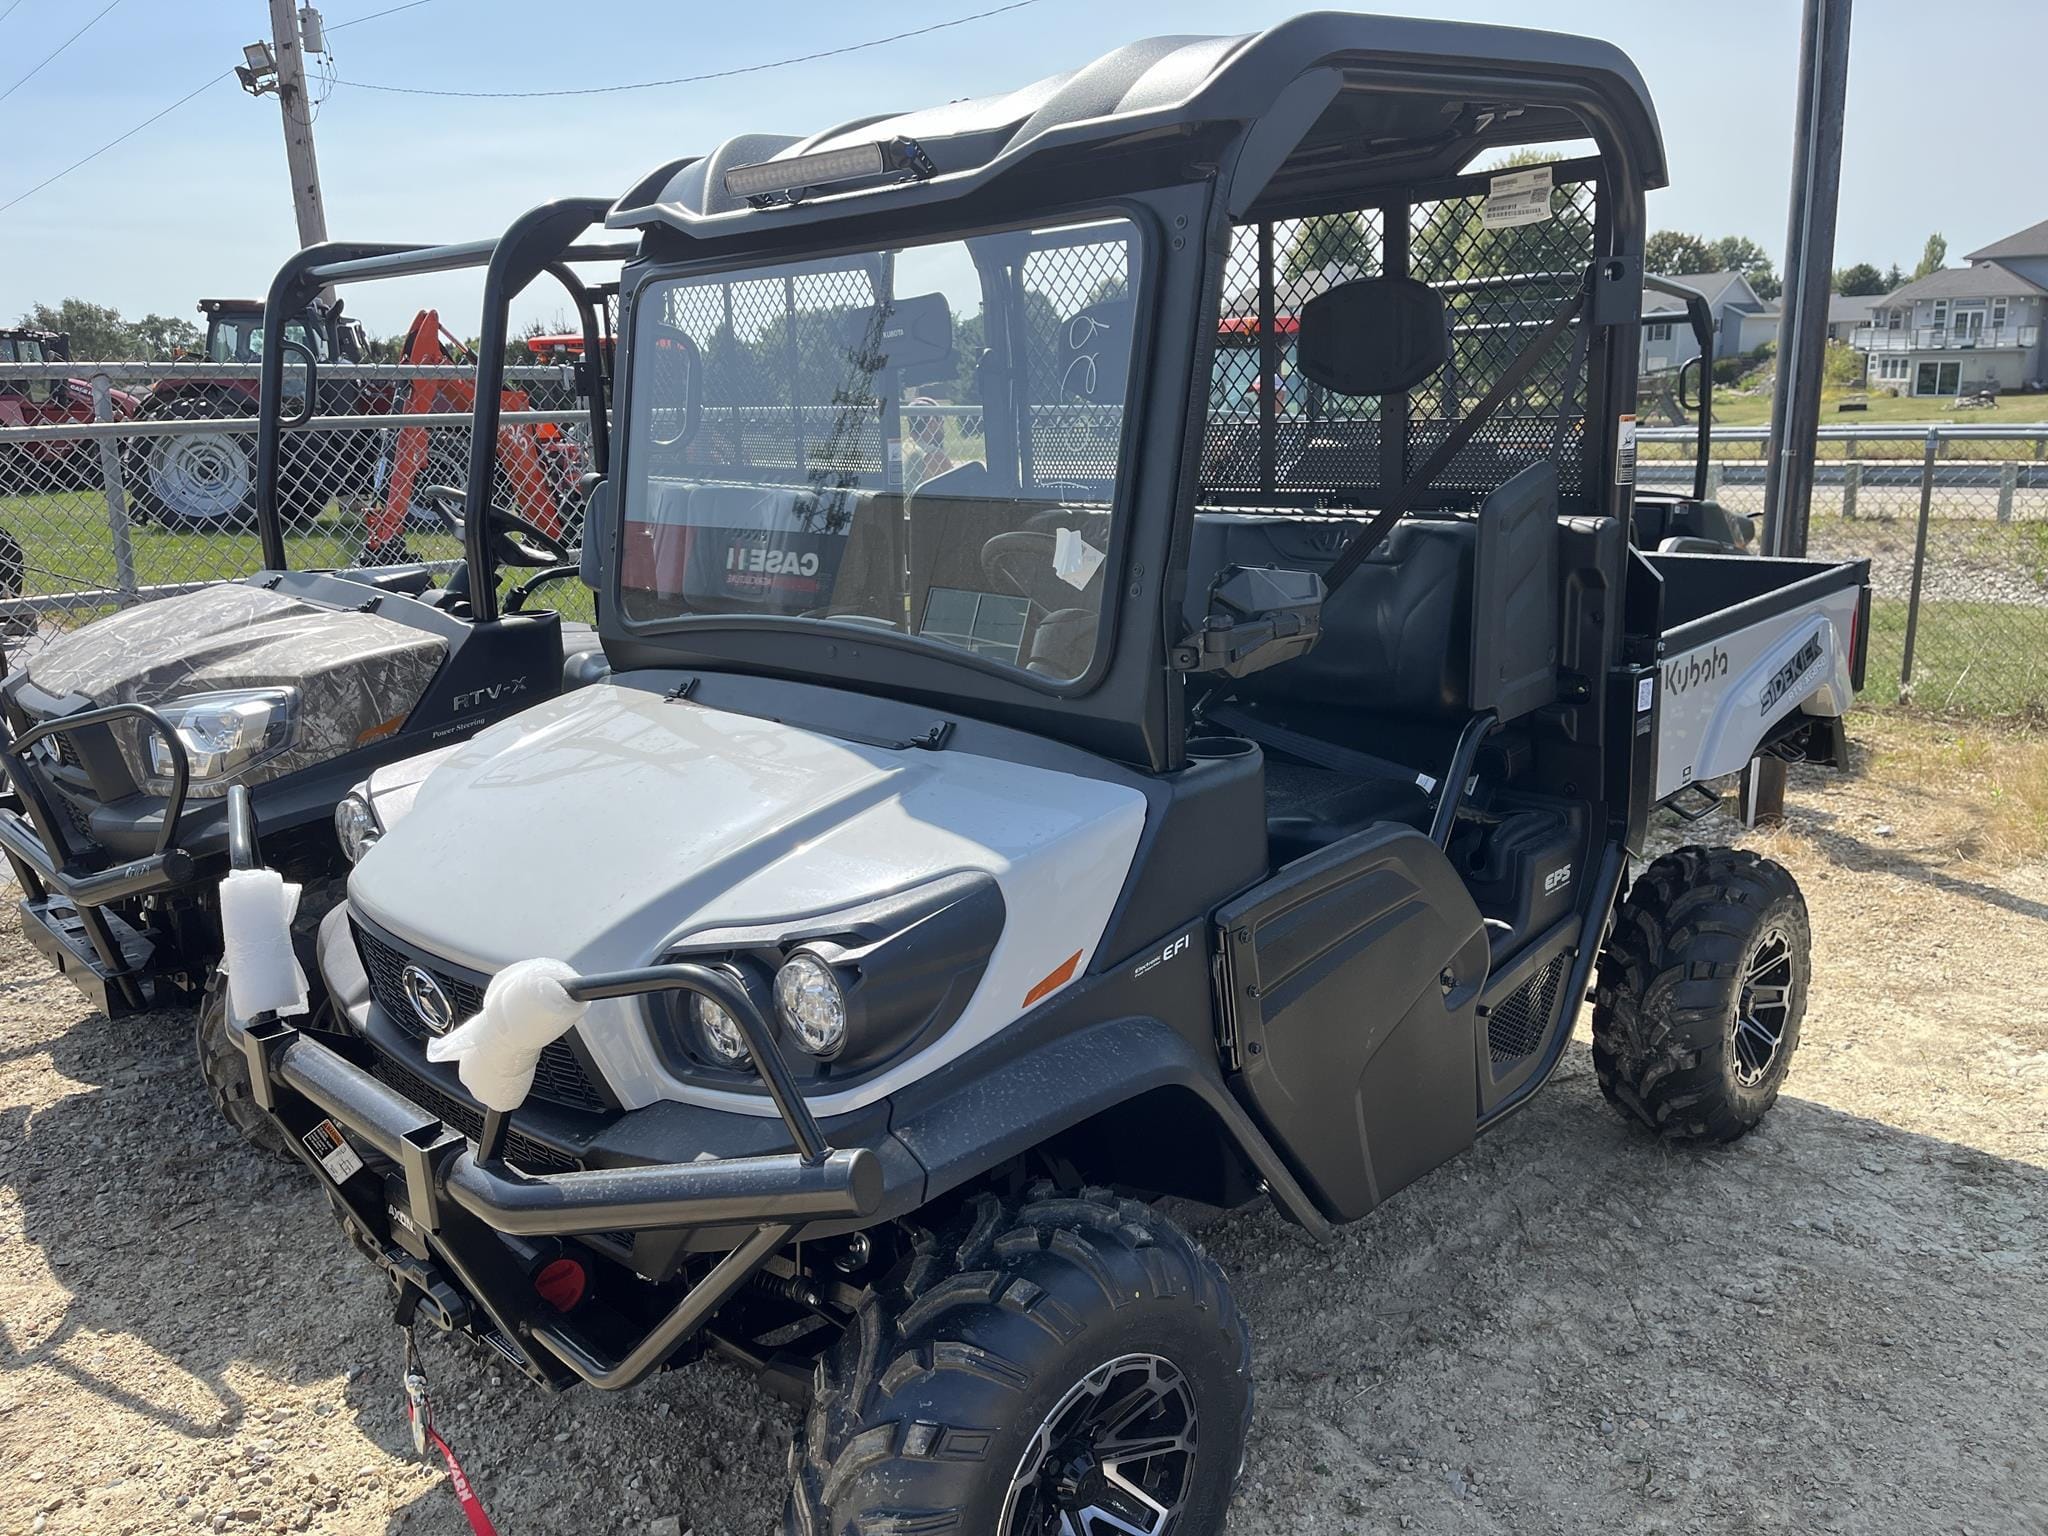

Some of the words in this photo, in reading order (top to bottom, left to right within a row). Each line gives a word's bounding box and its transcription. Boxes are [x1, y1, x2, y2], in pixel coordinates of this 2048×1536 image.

[1665, 645, 1728, 695] Kubota
[453, 675, 527, 711] RTV-X
[432, 726, 455, 739] Power
[456, 717, 486, 732] Steering
[1545, 863, 1571, 890] EPS
[1163, 934, 1189, 961] EFI
[446, 1453, 473, 1502] WARN
